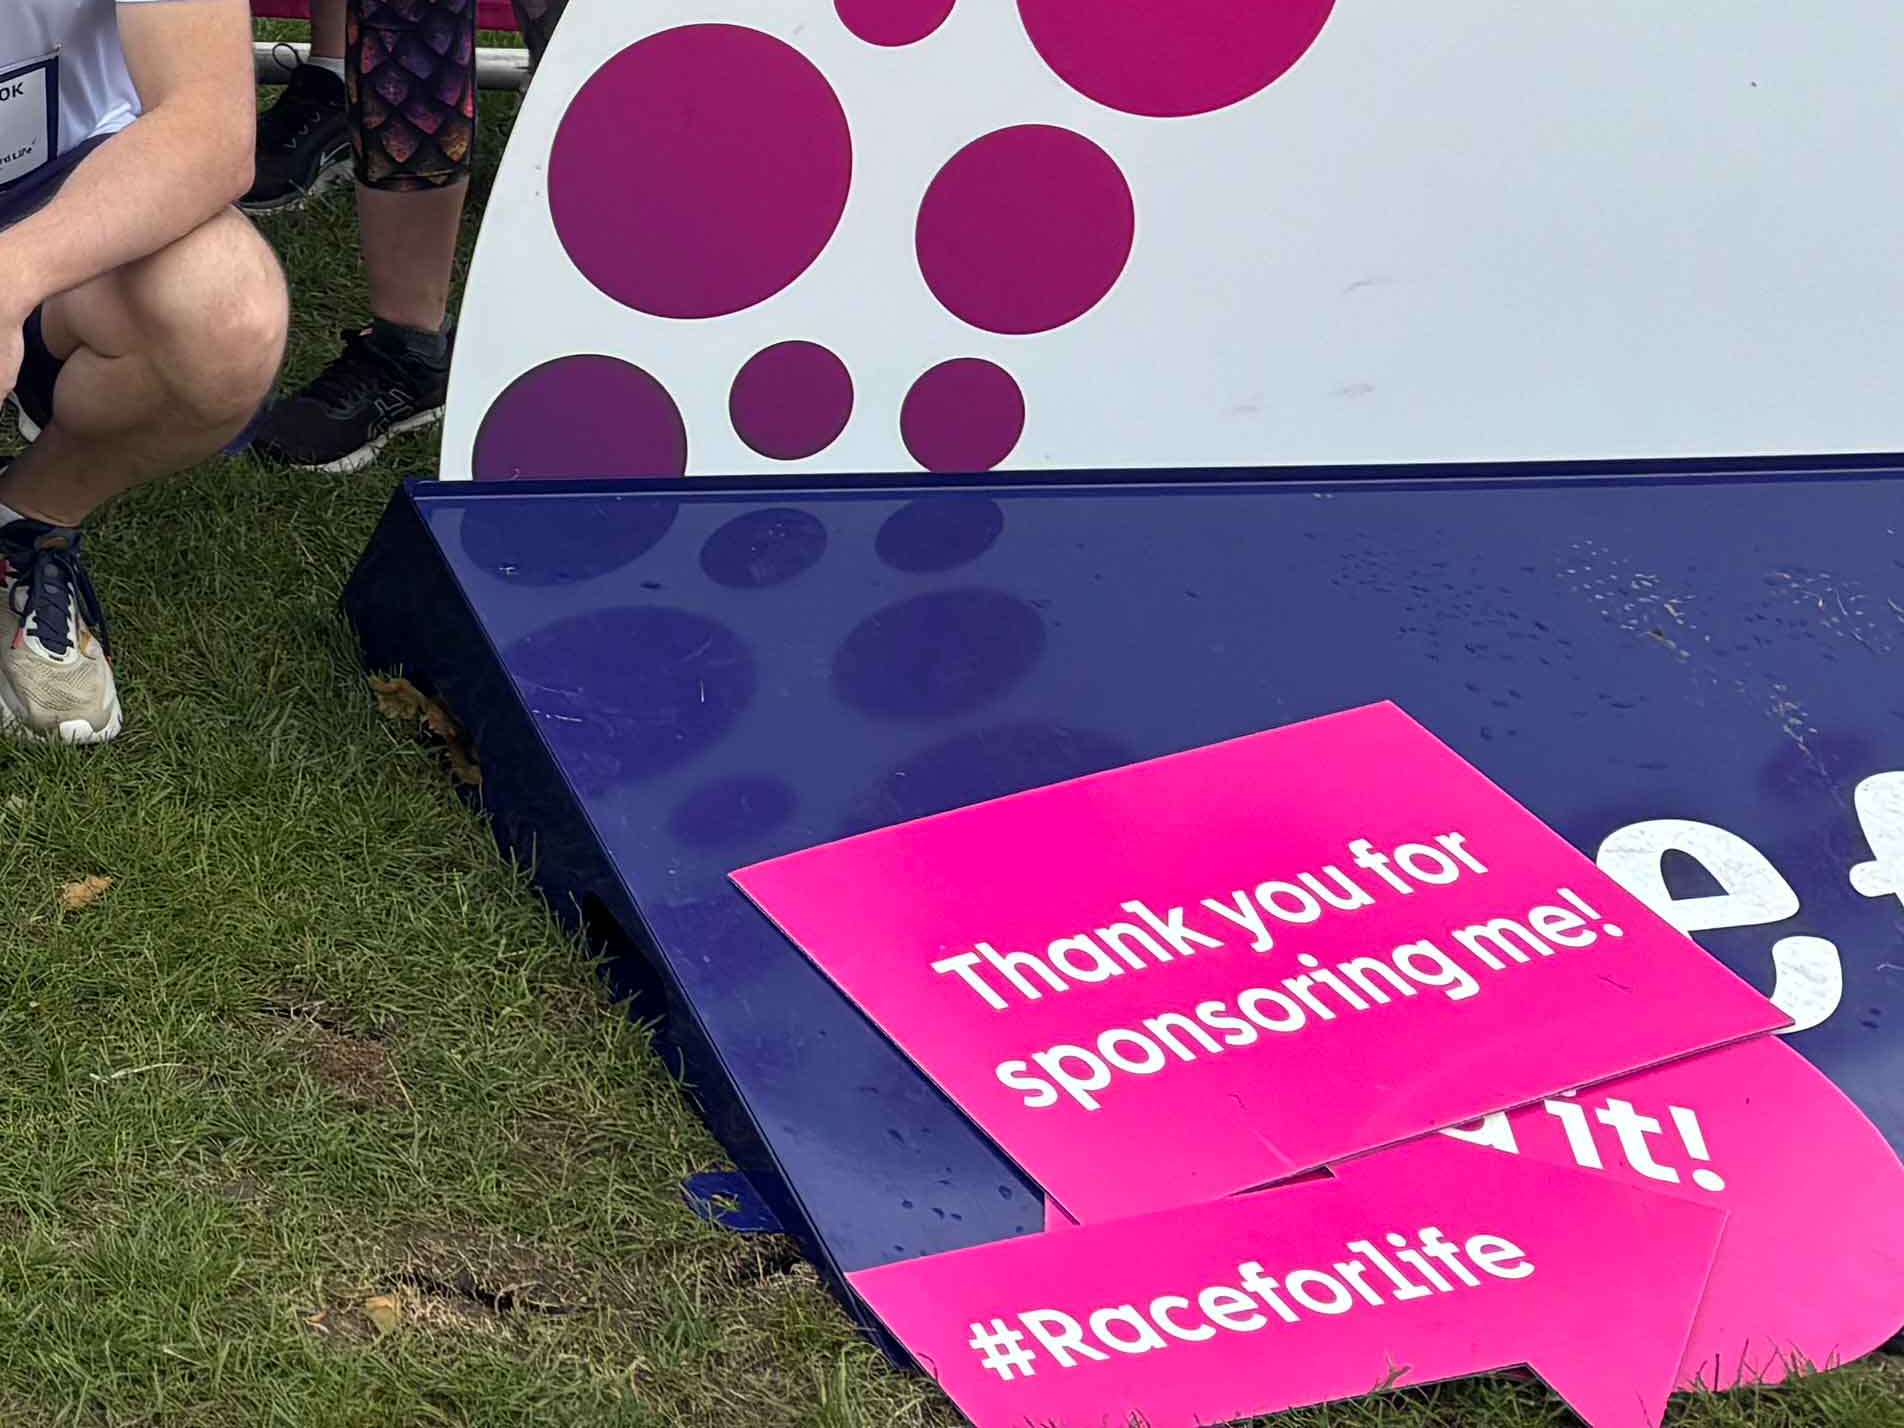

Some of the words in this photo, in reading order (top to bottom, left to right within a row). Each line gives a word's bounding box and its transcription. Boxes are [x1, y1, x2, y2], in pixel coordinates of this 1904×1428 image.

[933, 897, 1197, 1012] Thank
[1199, 860, 1376, 957] you
[1347, 830, 1490, 911] for
[995, 939, 1480, 1113] sponsoring
[1475, 885, 1625, 972] me!
[968, 1224, 1537, 1383] #Raceforlife
